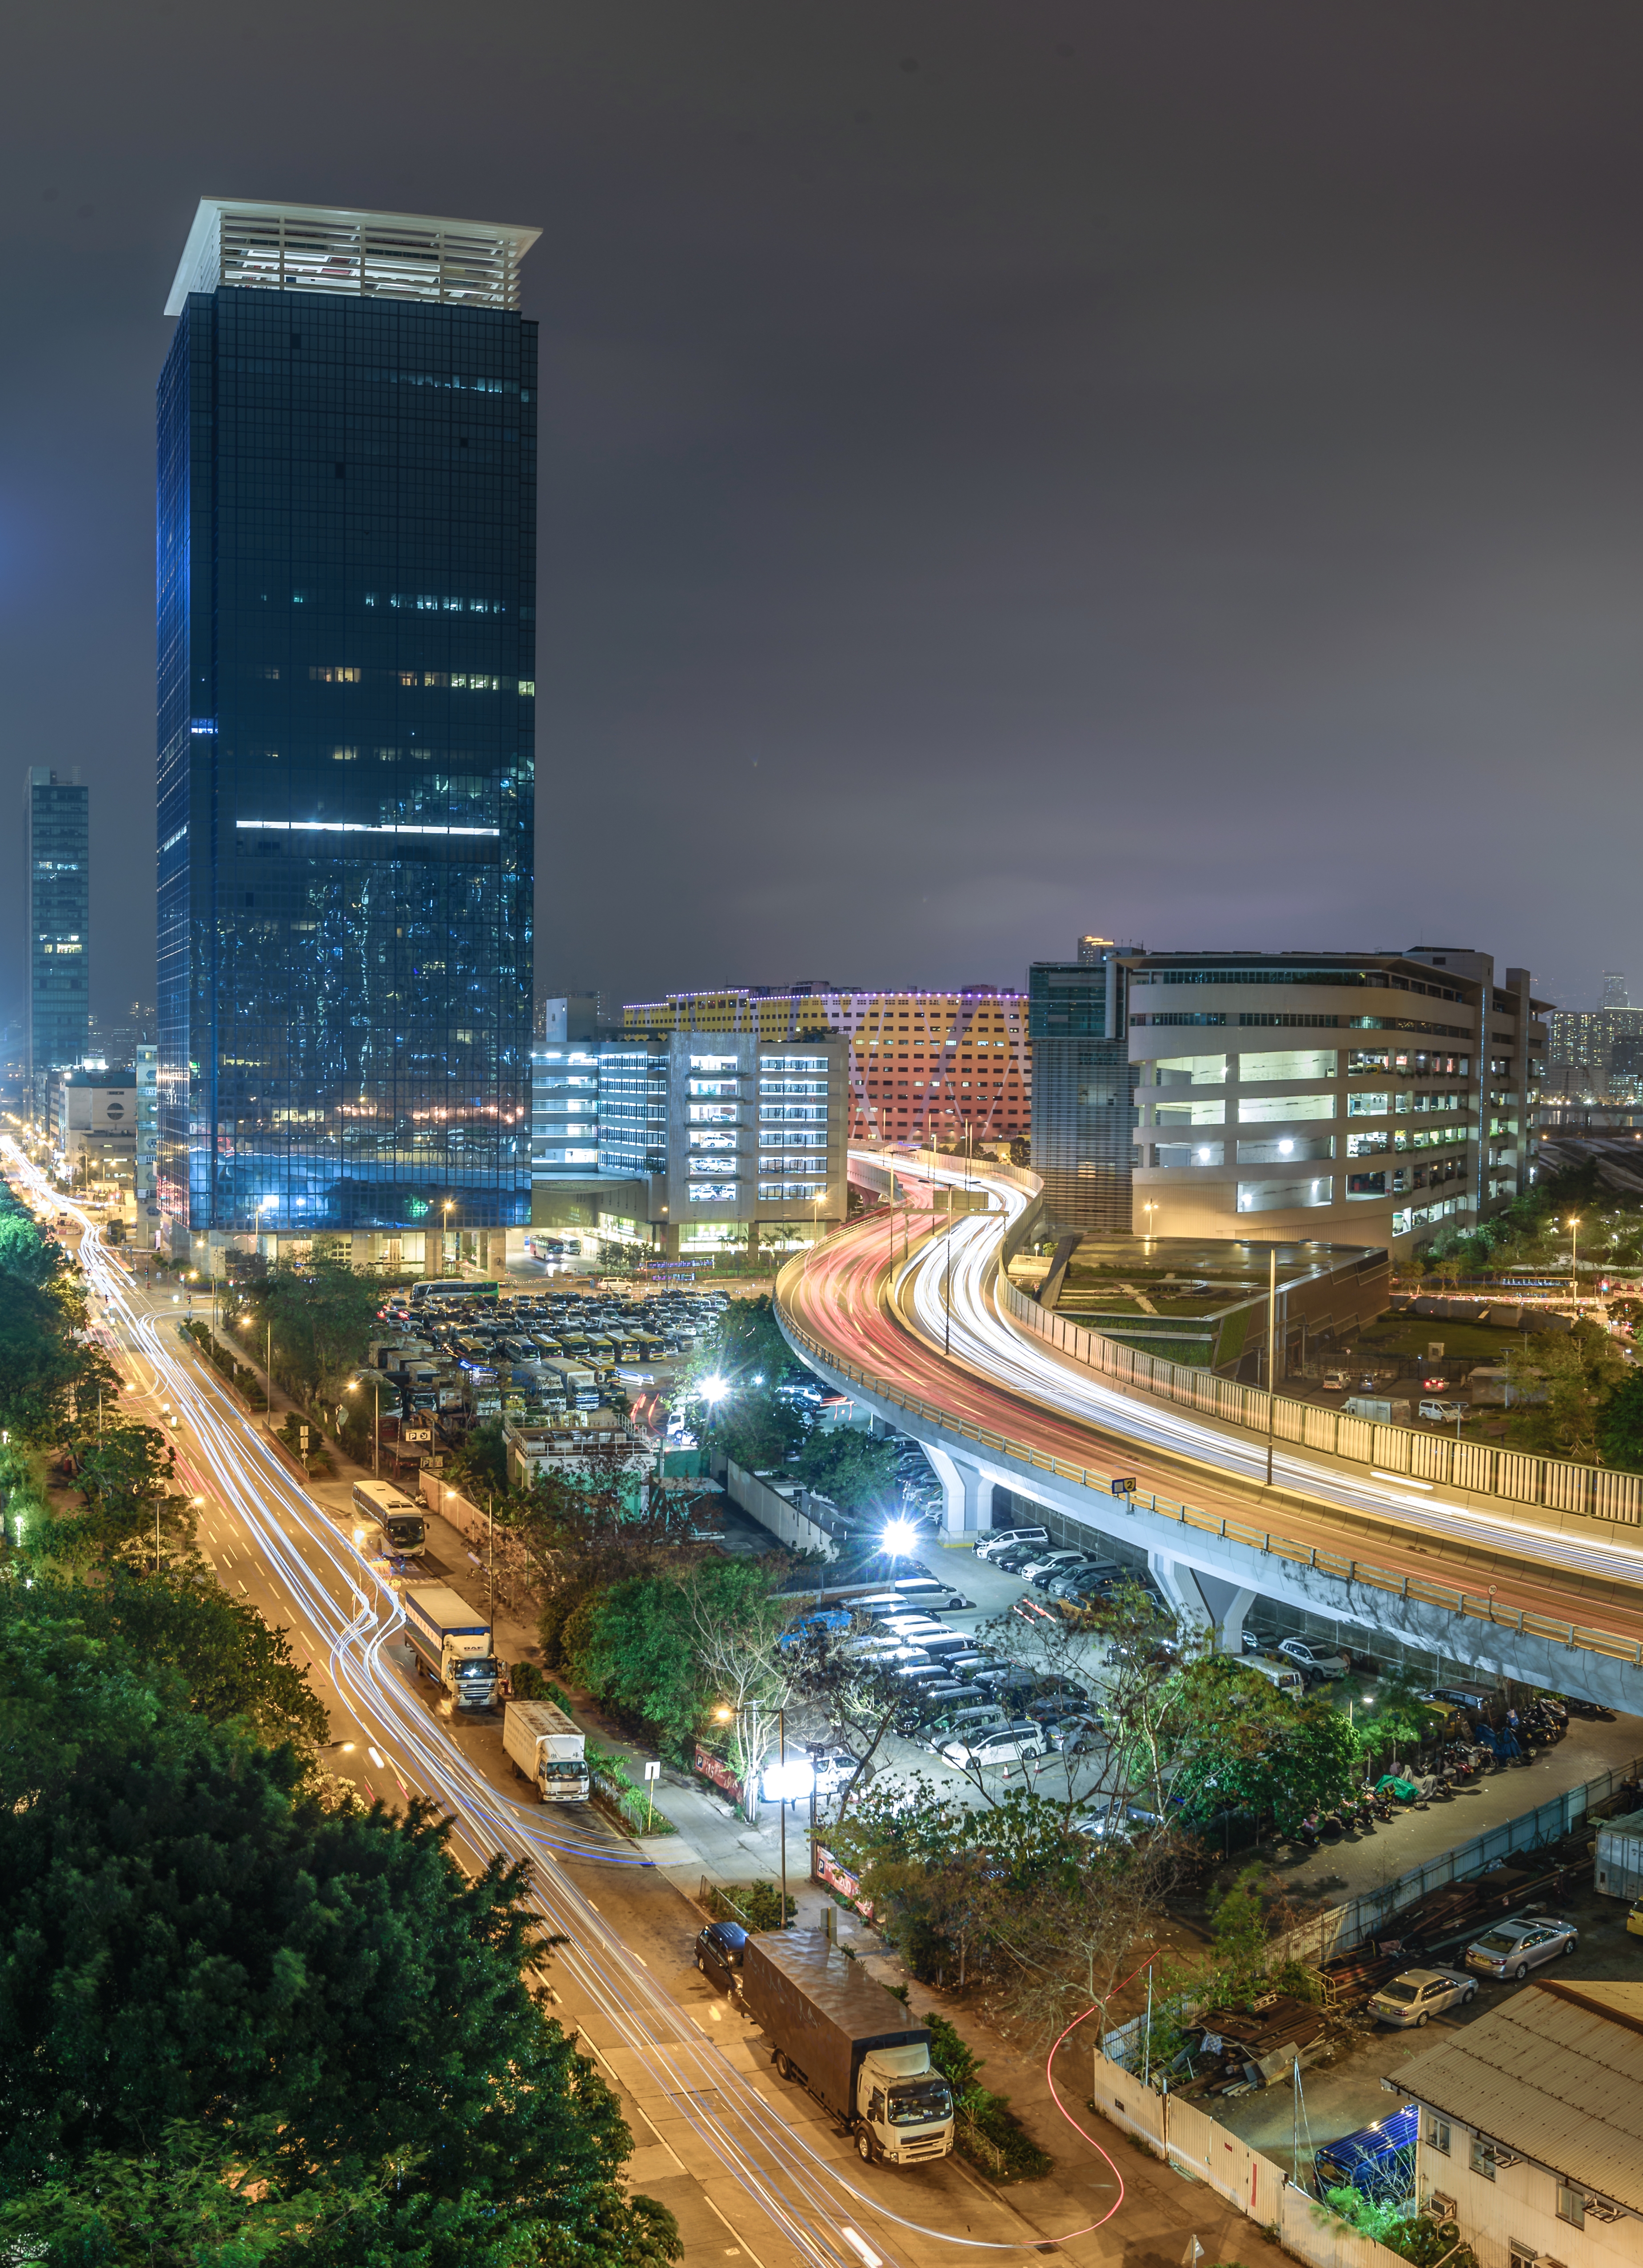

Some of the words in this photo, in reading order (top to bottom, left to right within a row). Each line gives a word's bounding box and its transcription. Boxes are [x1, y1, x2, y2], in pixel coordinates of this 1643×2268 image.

[1127, 1480, 1133, 1489] 2
[698, 1756, 702, 1765] P
[818, 1860, 824, 1870] P
